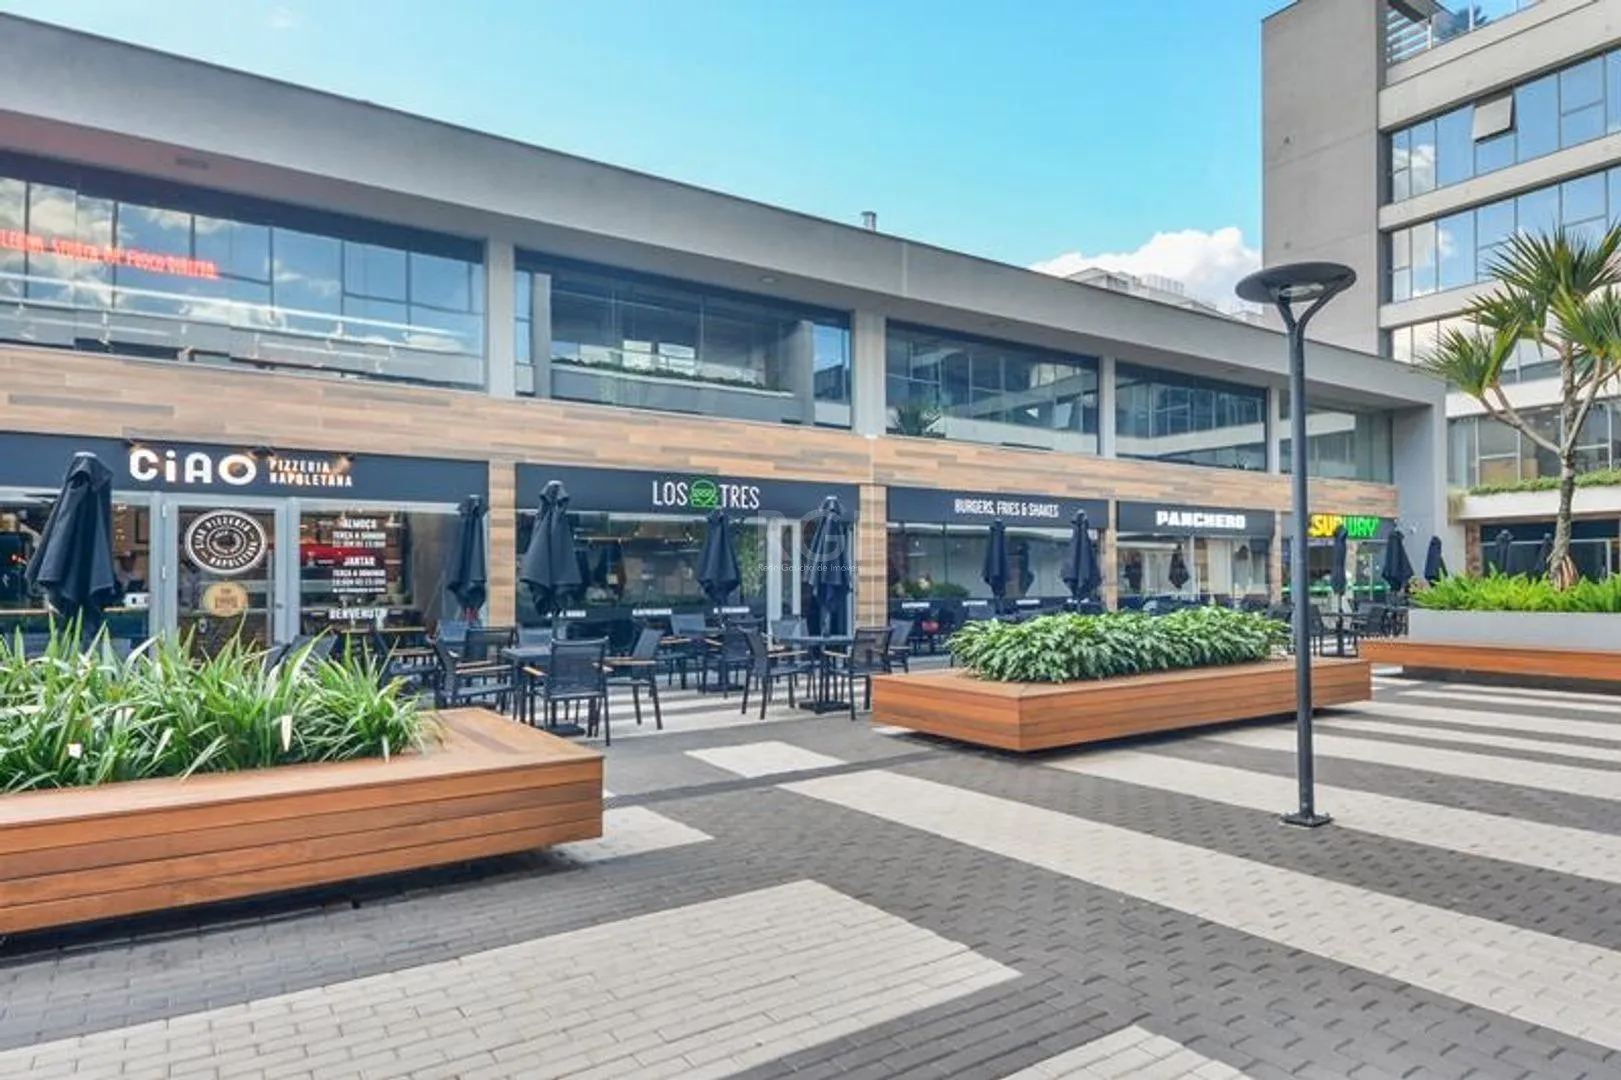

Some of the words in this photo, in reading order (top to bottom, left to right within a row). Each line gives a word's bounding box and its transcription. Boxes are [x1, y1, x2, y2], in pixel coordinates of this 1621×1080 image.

[269, 459, 330, 473] PIZZERIA
[269, 472, 353, 487] NAPOLETANA
[652, 480, 688, 506] LOS
[718, 484, 760, 509] TRES
[997, 500, 1020, 516] FRIES
[1028, 503, 1059, 518] SHAKES
[1155, 510, 1246, 530] PANCHERO
